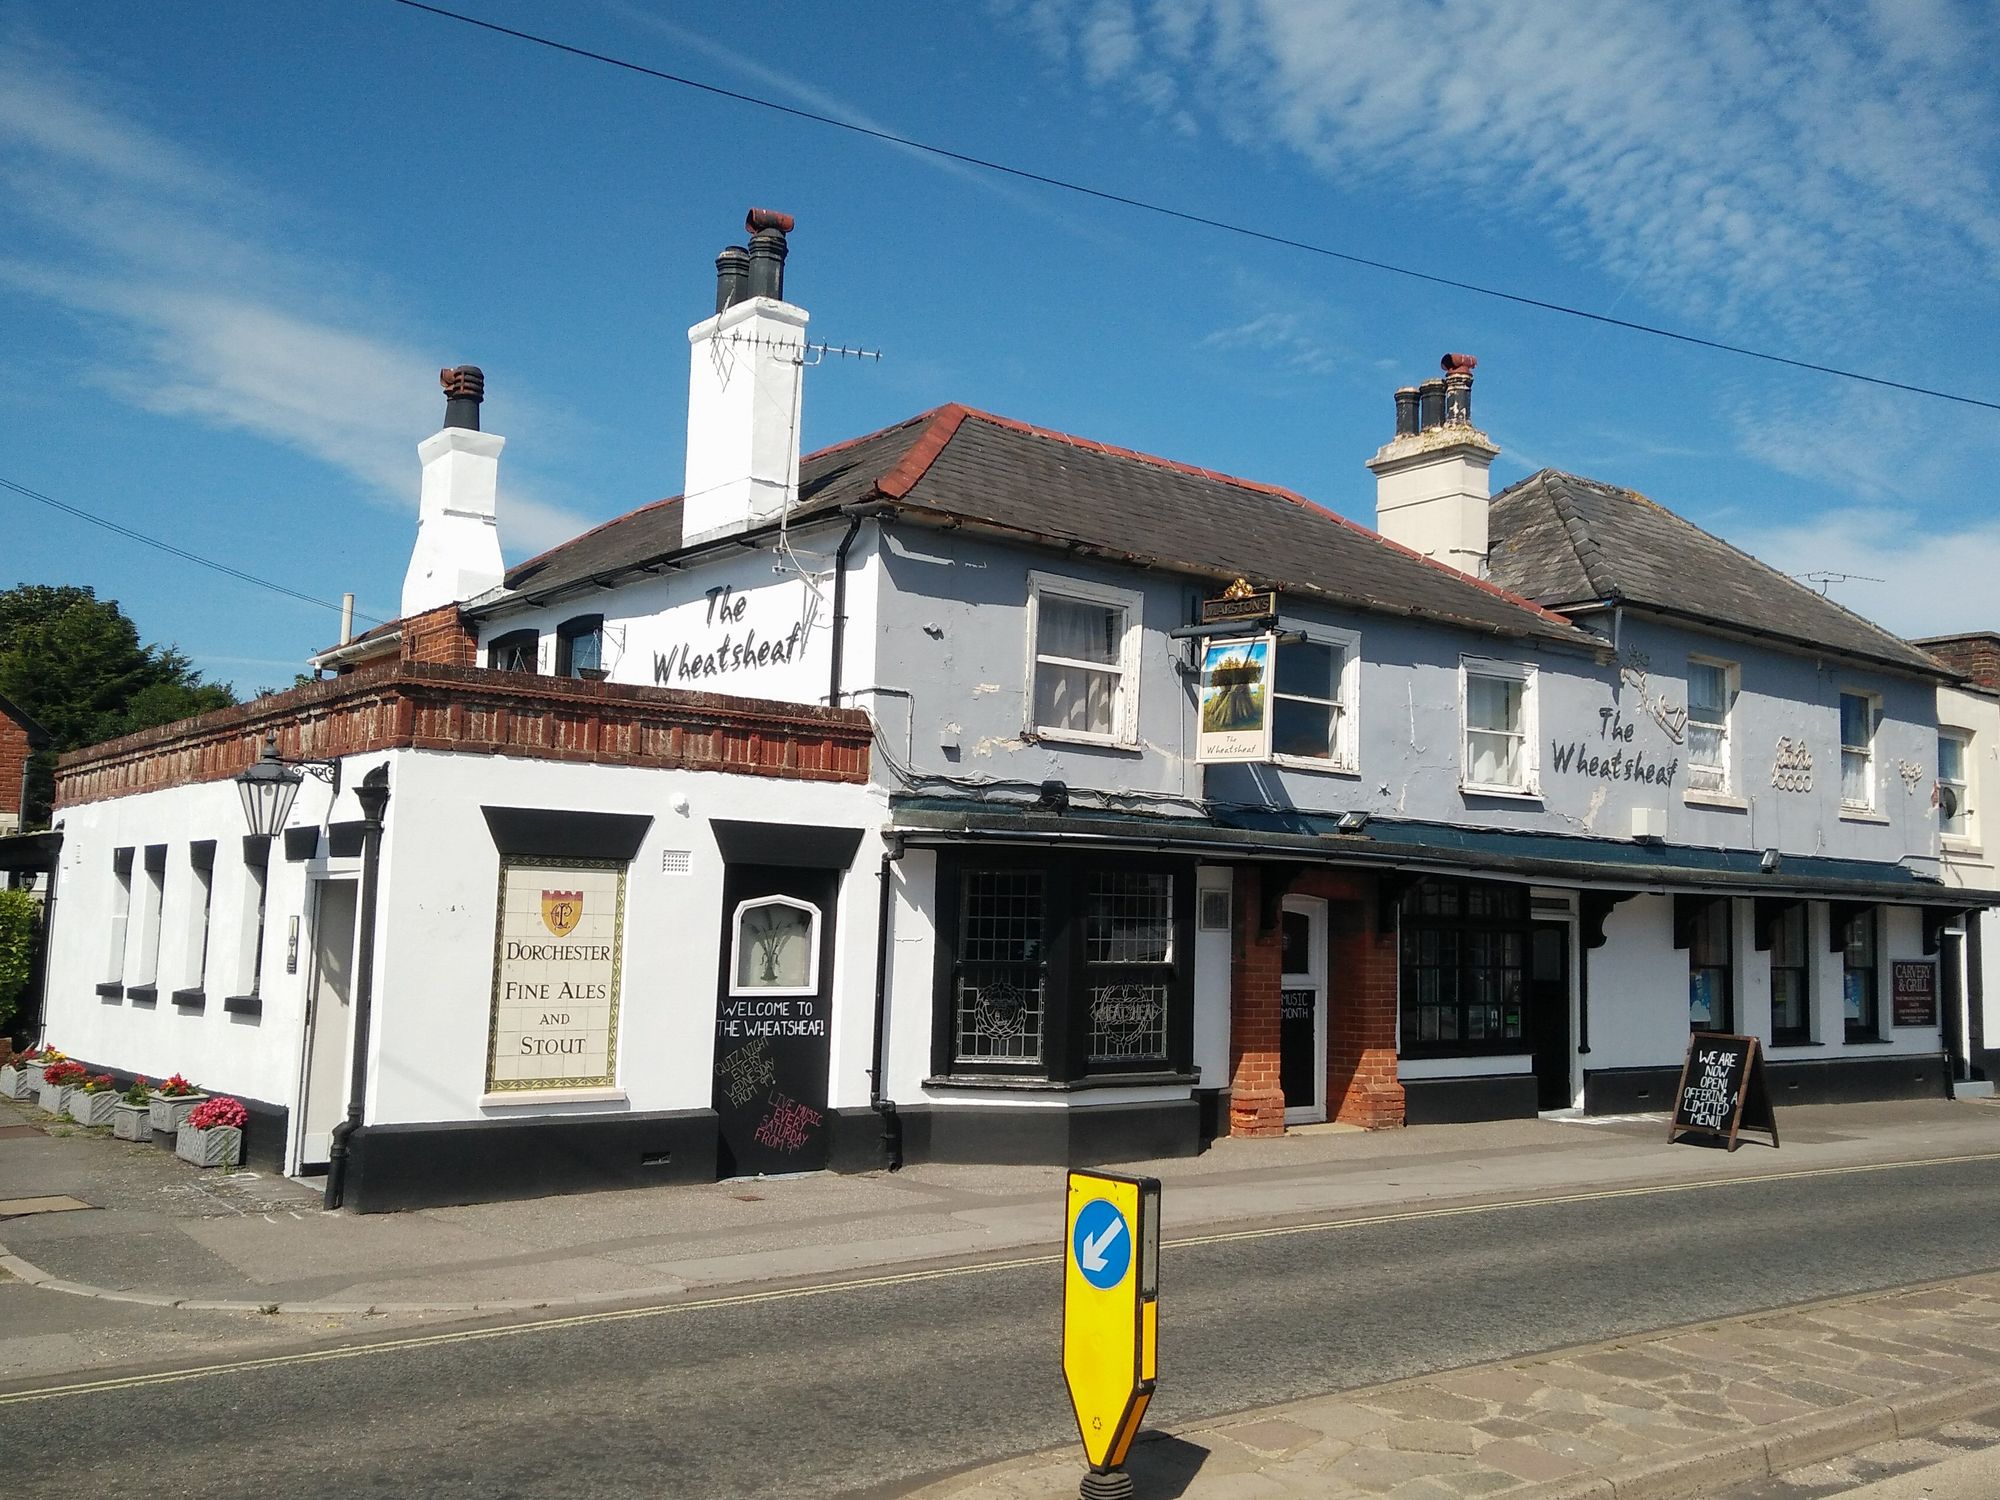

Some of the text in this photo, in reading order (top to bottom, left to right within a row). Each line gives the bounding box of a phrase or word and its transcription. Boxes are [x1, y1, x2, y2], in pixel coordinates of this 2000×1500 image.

[705, 585, 746, 628] The
[654, 622, 802, 686] Wheatsheaf
[1599, 707, 1634, 742] The
[1226, 735, 1237, 743] The
[1207, 744, 1256, 754] Wheatsheaf
[1552, 739, 1678, 788] Wheatsheaf
[507, 942, 611, 960] DORCHESTER
[1895, 964, 1931, 979] CARVERY
[505, 981, 606, 999] FINE ALES
[1898, 979, 1929, 992] & GRILL
[1281, 992, 1308, 1007] MUSIC
[720, 1001, 813, 1017] WELCOME TO
[1281, 1007, 1309, 1020] MONTH
[539, 1013, 570, 1025] AND
[716, 1019, 825, 1037] THE WHEATSHEAF!
[521, 1036, 586, 1055] STOUT
[714, 1035, 769, 1077] QUIZ NIGHT
[1699, 1050, 1738, 1067] WE ARE
[731, 1053, 762, 1080] EVERY
[1704, 1065, 1730, 1078] NOW
[723, 1057, 775, 1098] WEDNESDAY
[1700, 1076, 1728, 1094] OPEN!
[731, 1084, 759, 1109] FROM
[1684, 1087, 1738, 1105] OFFERING A
[768, 1089, 823, 1127] LIVE MUSIC
[1683, 1098, 1730, 1117] LIMITED
[773, 1107, 807, 1131] EVERY
[1689, 1113, 1721, 1131] MENU!
[754, 1127, 784, 1152] FROM
[760, 1114, 809, 1147] SATURDAY
